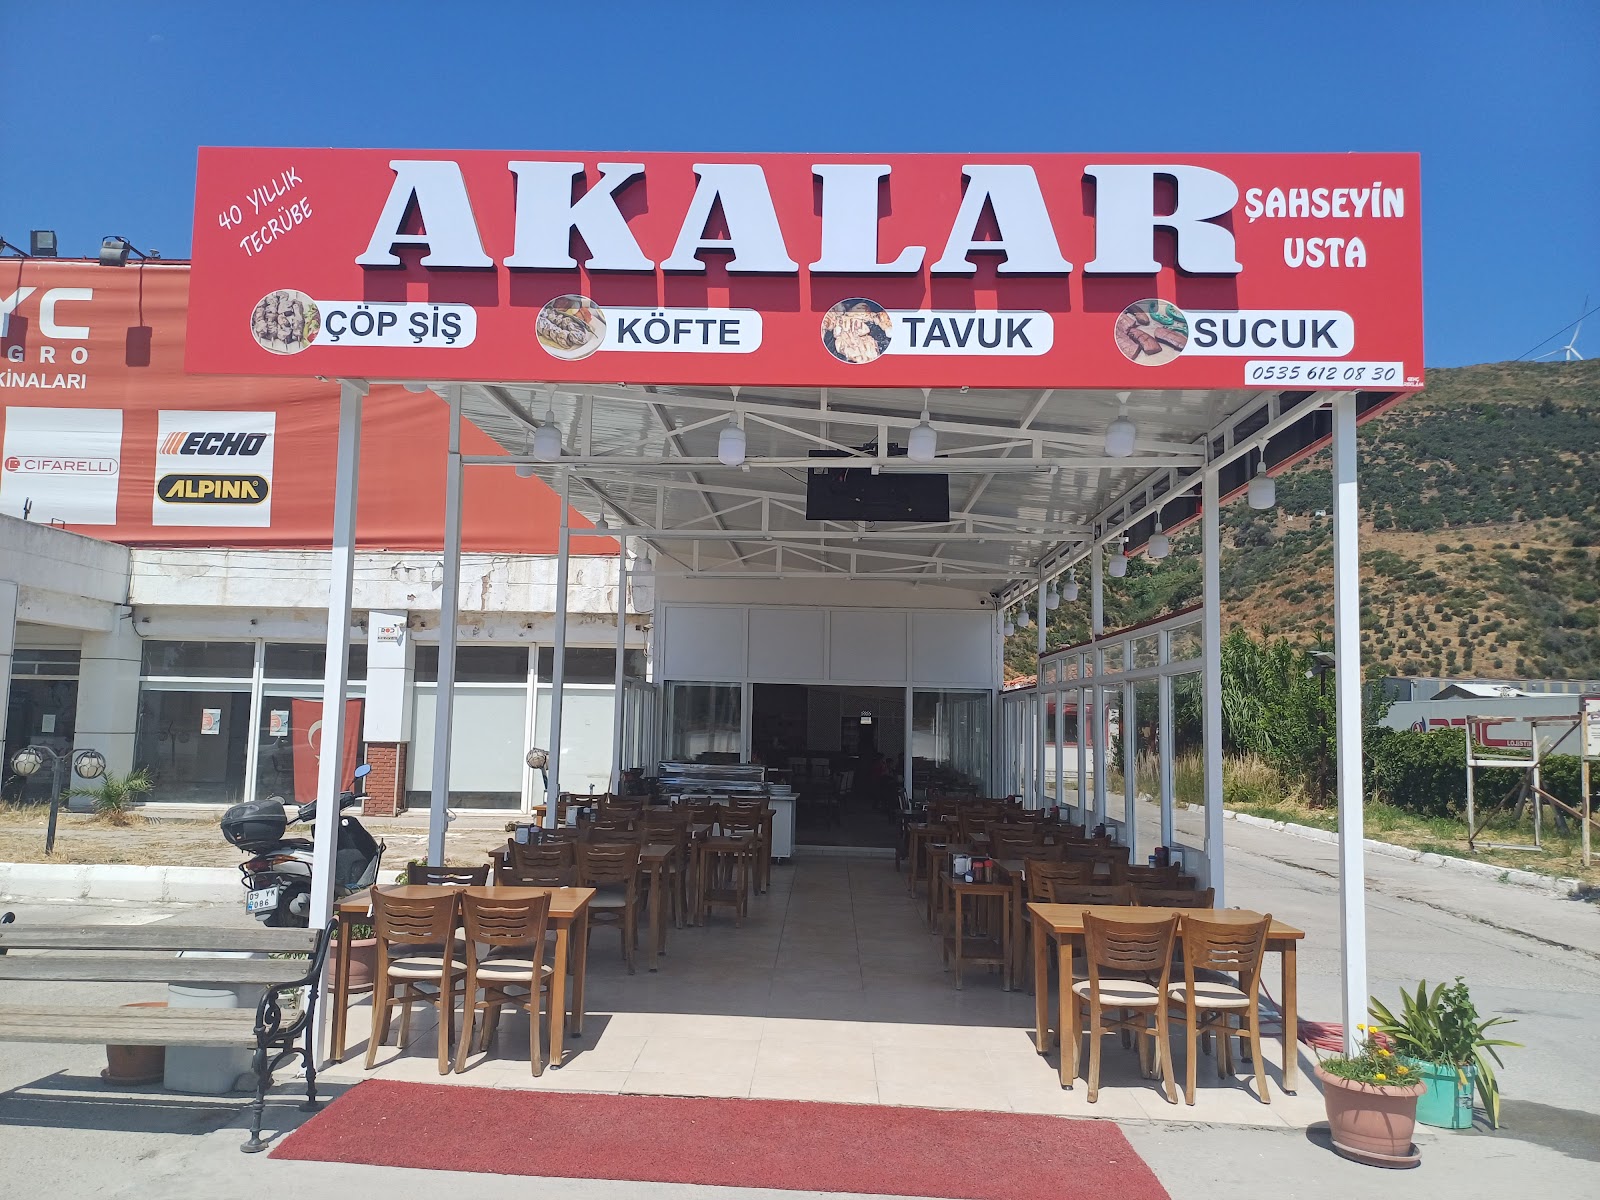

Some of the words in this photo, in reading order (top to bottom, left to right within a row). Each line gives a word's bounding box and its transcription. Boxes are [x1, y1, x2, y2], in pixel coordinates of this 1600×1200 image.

[218, 204, 242, 230] 40
[246, 166, 303, 215] YILLIK
[1244, 181, 1405, 224] ŞAHSEYİN
[239, 196, 313, 257] TECRÜBE
[355, 159, 1243, 275] AKALAR
[1283, 236, 1367, 268] USTA
[325, 305, 397, 342] ÇÖP
[408, 306, 462, 344] ŞİŞ
[617, 312, 741, 346] KÖFTE
[902, 317, 1033, 349] TAVUK
[1193, 317, 1339, 350] SUCUK
[1252, 365, 1301, 380] 0535
[1306, 366, 1338, 380] 612
[1343, 367, 1366, 381] 08
[1371, 367, 1396, 381] 30
[180, 432, 267, 456] ECHO
[24, 459, 112, 473] CIFARELLI
[165, 479, 260, 499] ALPINA
[249, 893, 260, 901] 09
